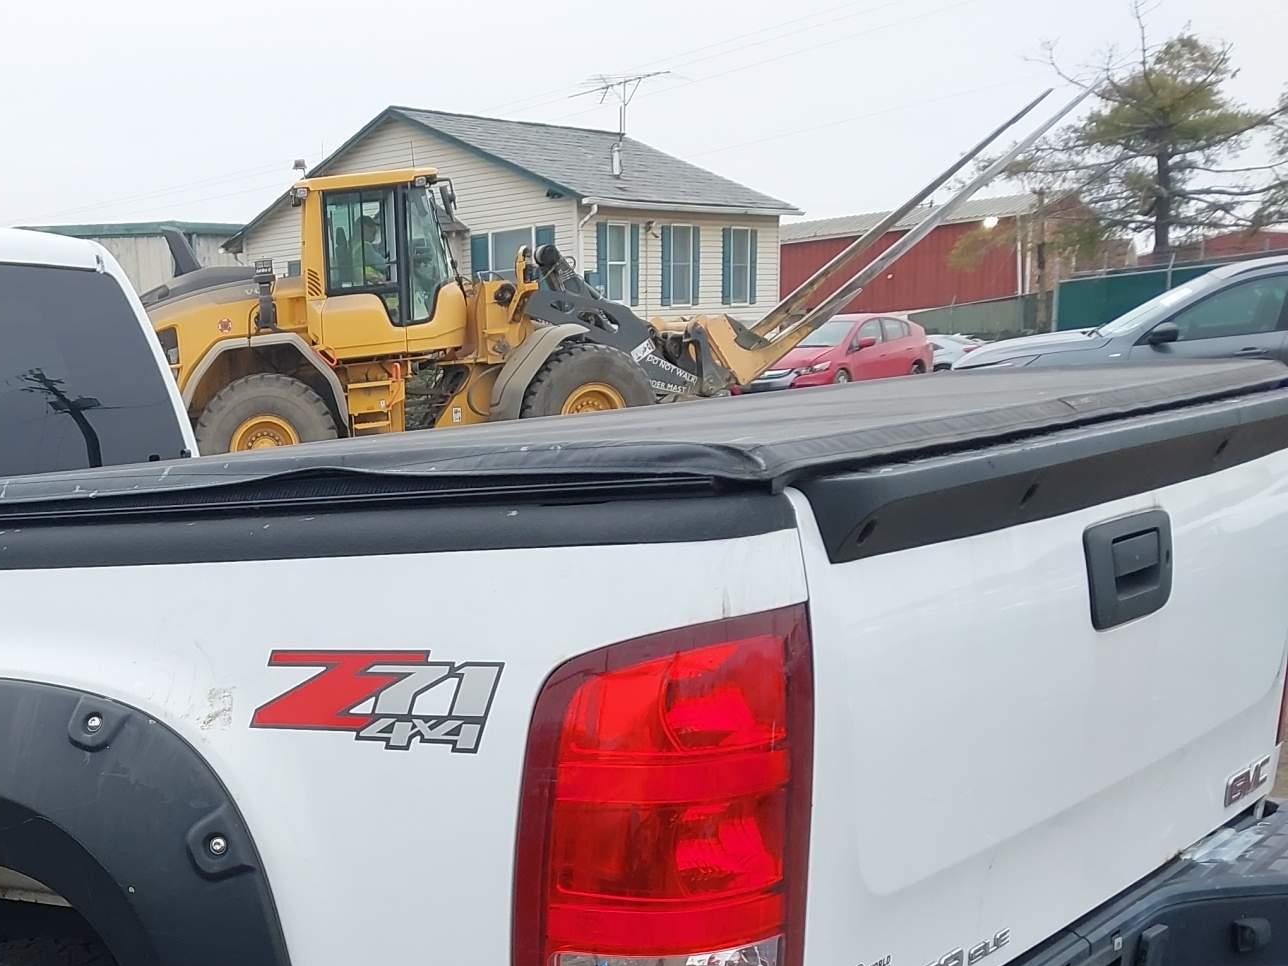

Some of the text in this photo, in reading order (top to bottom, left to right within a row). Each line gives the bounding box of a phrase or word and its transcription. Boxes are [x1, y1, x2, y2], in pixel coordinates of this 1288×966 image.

[646, 354, 658, 365] DO
[659, 359, 674, 374] NOT
[668, 383, 688, 393] MAST
[249, 649, 506, 732] Z71
[968, 927, 1010, 966] SLE
